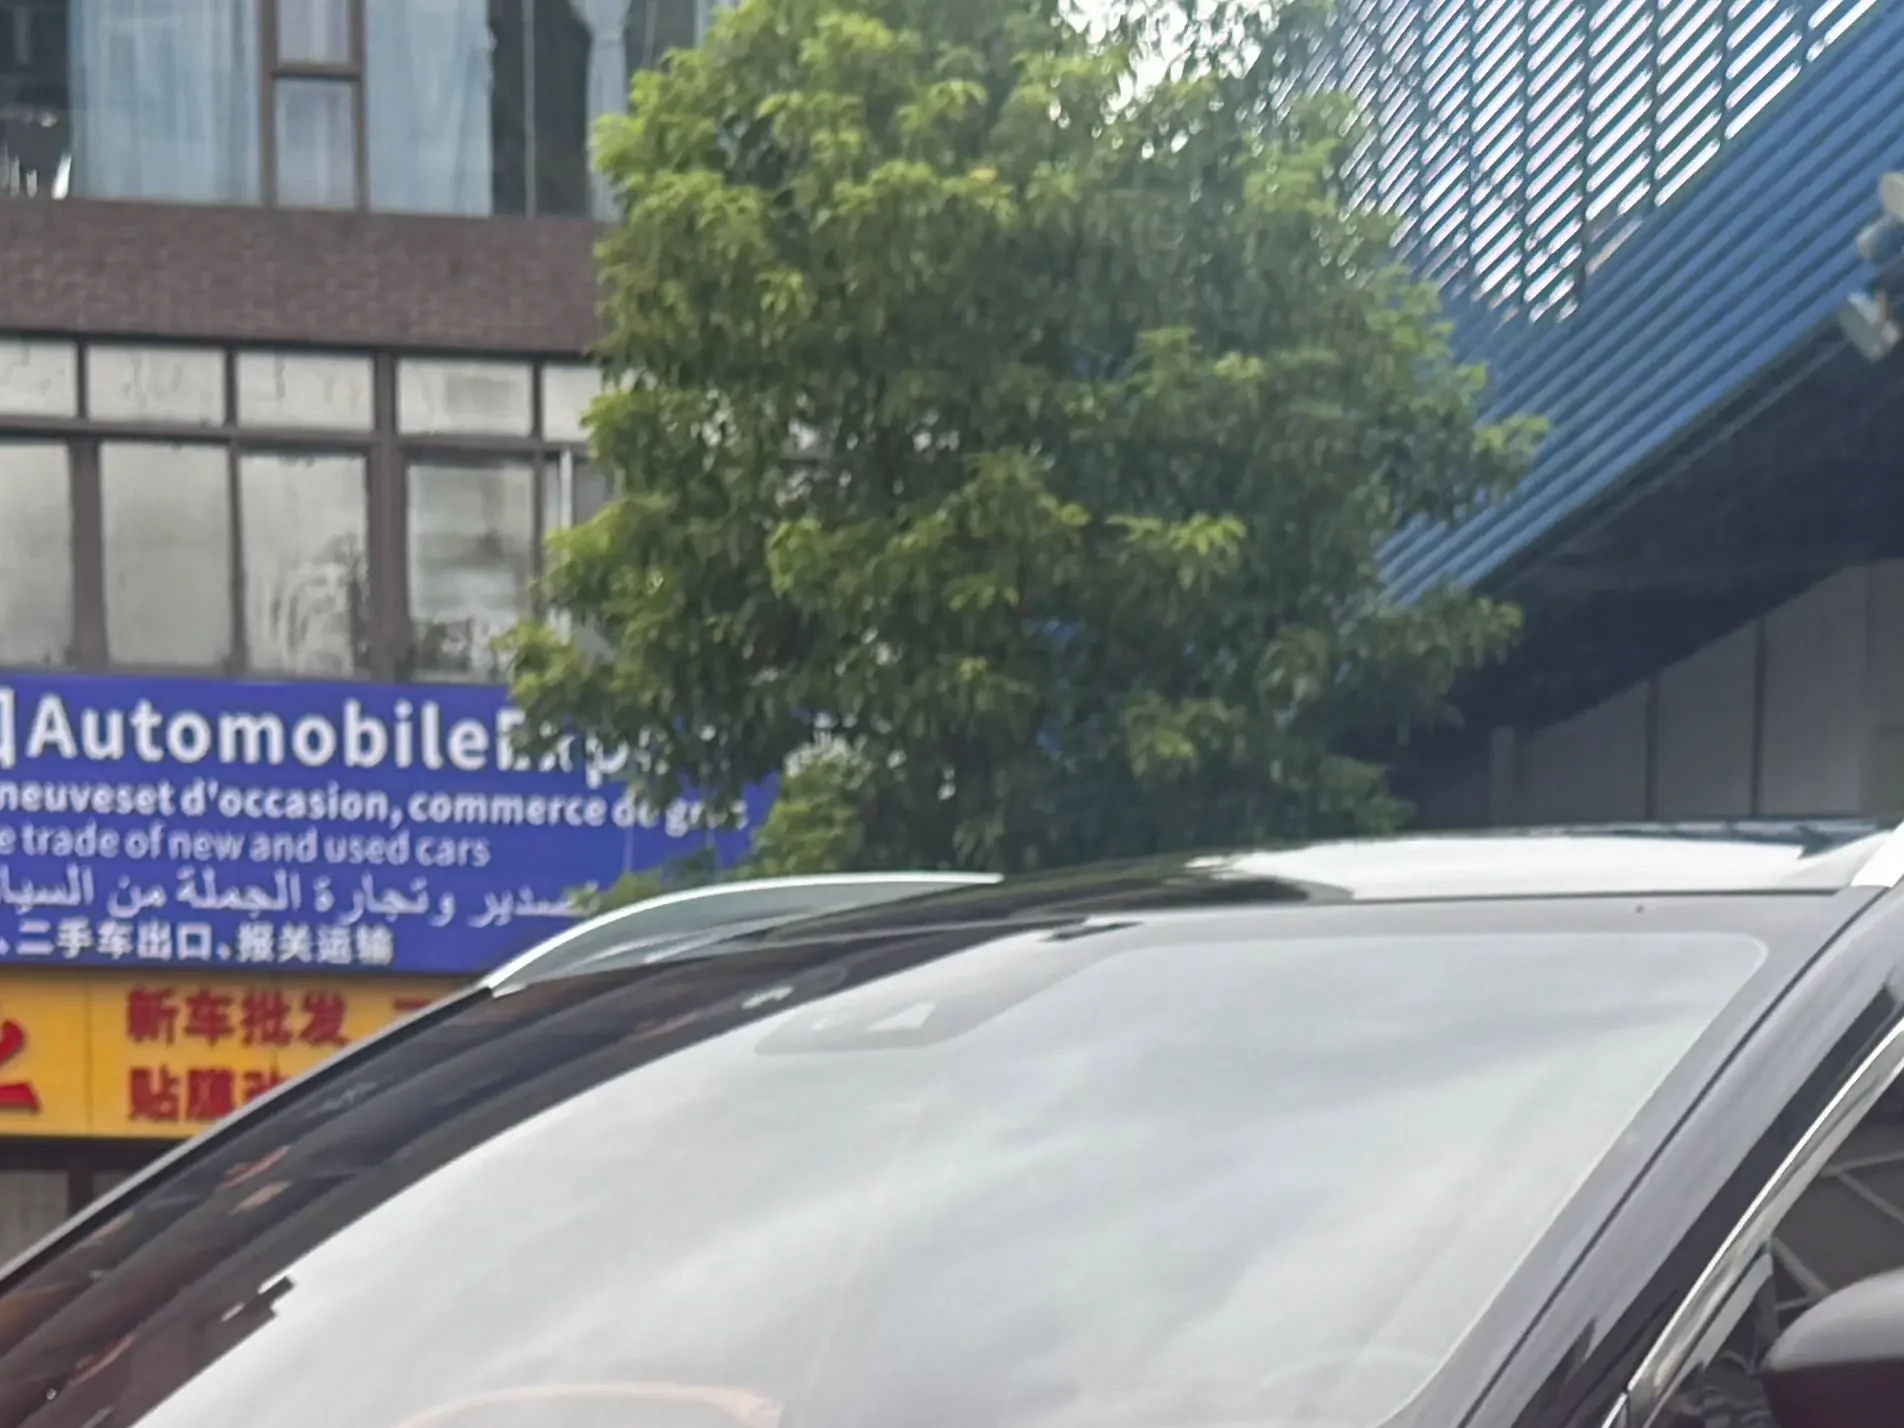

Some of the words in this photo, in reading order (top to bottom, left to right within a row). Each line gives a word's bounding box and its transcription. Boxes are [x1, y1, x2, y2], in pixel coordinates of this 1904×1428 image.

[408, 791, 606, 827] commerce
[22, 820, 119, 858] trade
[125, 822, 164, 859] of
[169, 833, 244, 861] new
[250, 829, 317, 863] and
[325, 831, 409, 865] used
[416, 838, 490, 867] cars
[107, 874, 167, 918] من
[176, 866, 302, 919] الجملة
[126, 986, 348, 1046] 新车批发
